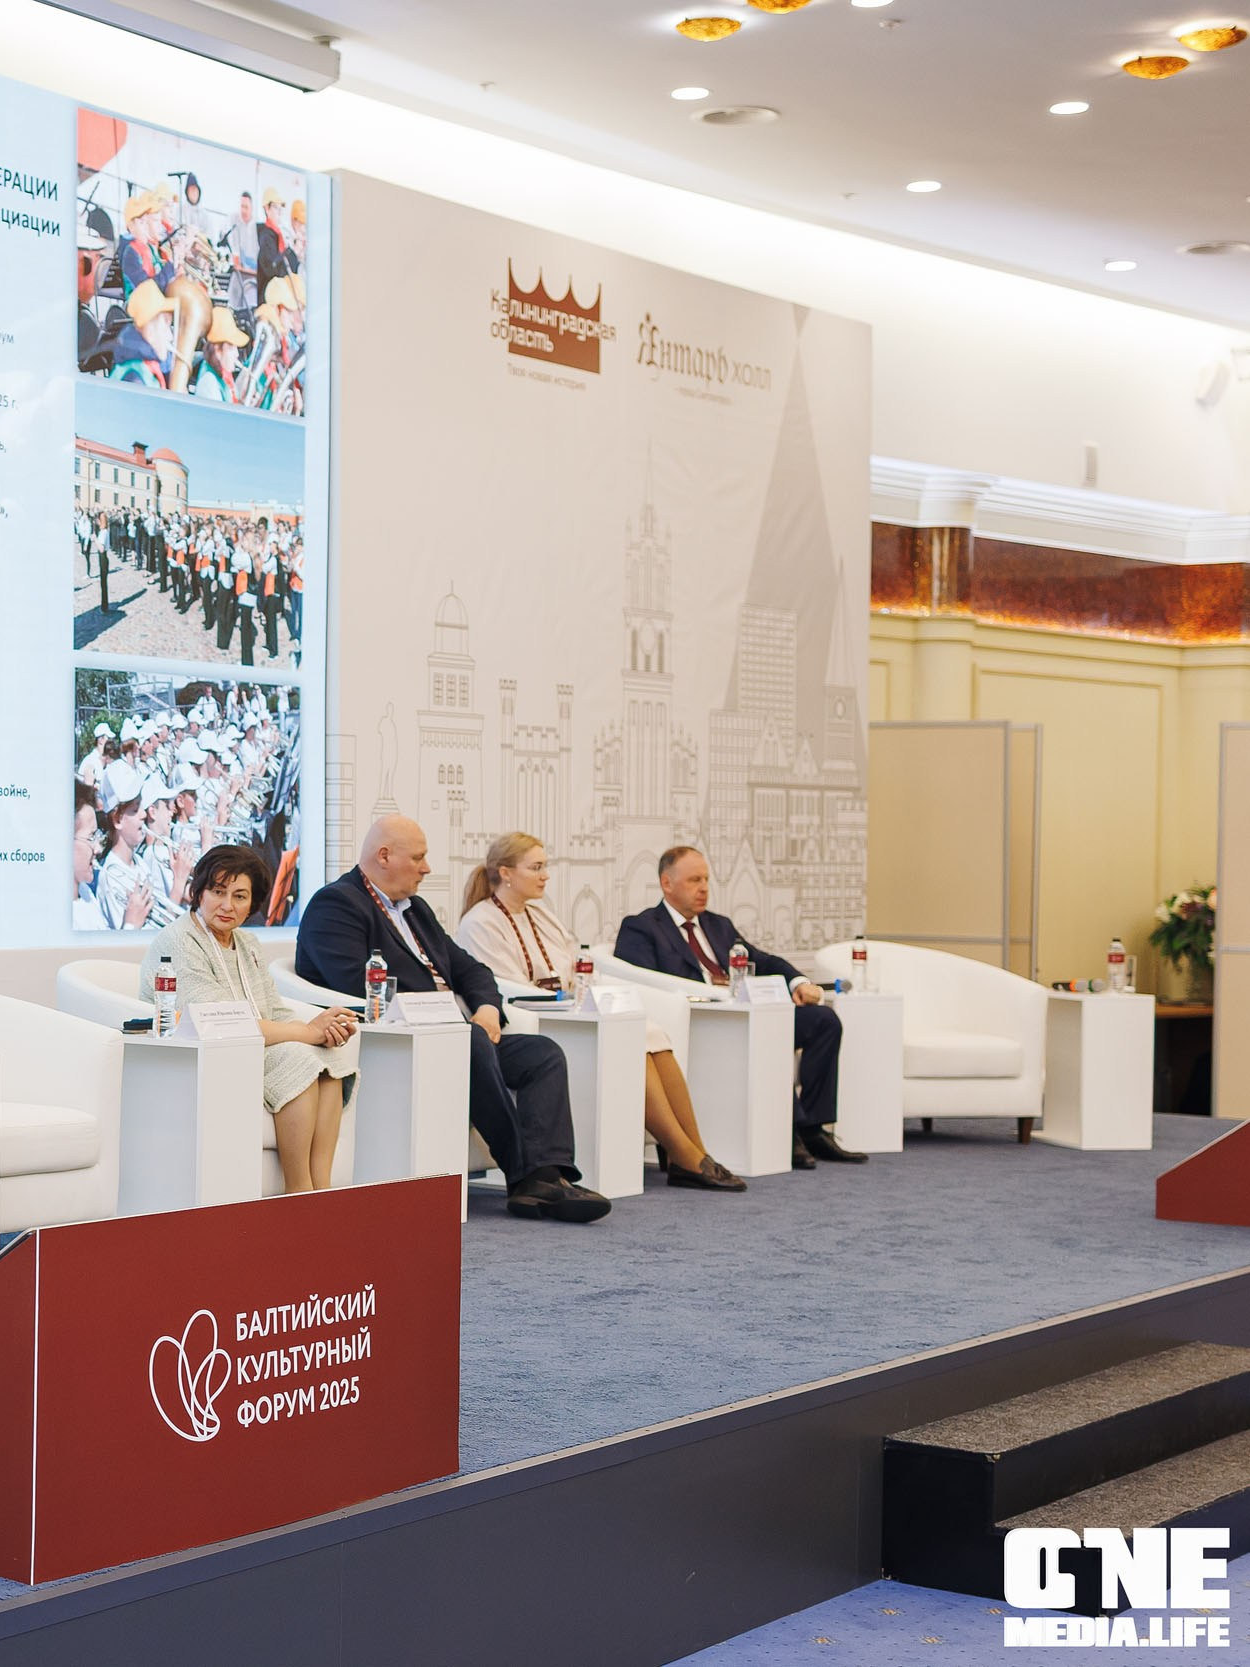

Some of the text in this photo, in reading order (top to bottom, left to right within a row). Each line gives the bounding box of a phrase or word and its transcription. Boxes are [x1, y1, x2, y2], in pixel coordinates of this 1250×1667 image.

[490, 289, 617, 343] Калининградская
[490, 321, 556, 353] область
[9, 847, 46, 865] сборов
[235, 1283, 377, 1342] БАЛТИЙСКИЙ
[236, 1326, 372, 1385] КУЛЬТУРНЫЙ
[237, 1375, 360, 1428] ФОРУМ 2025
